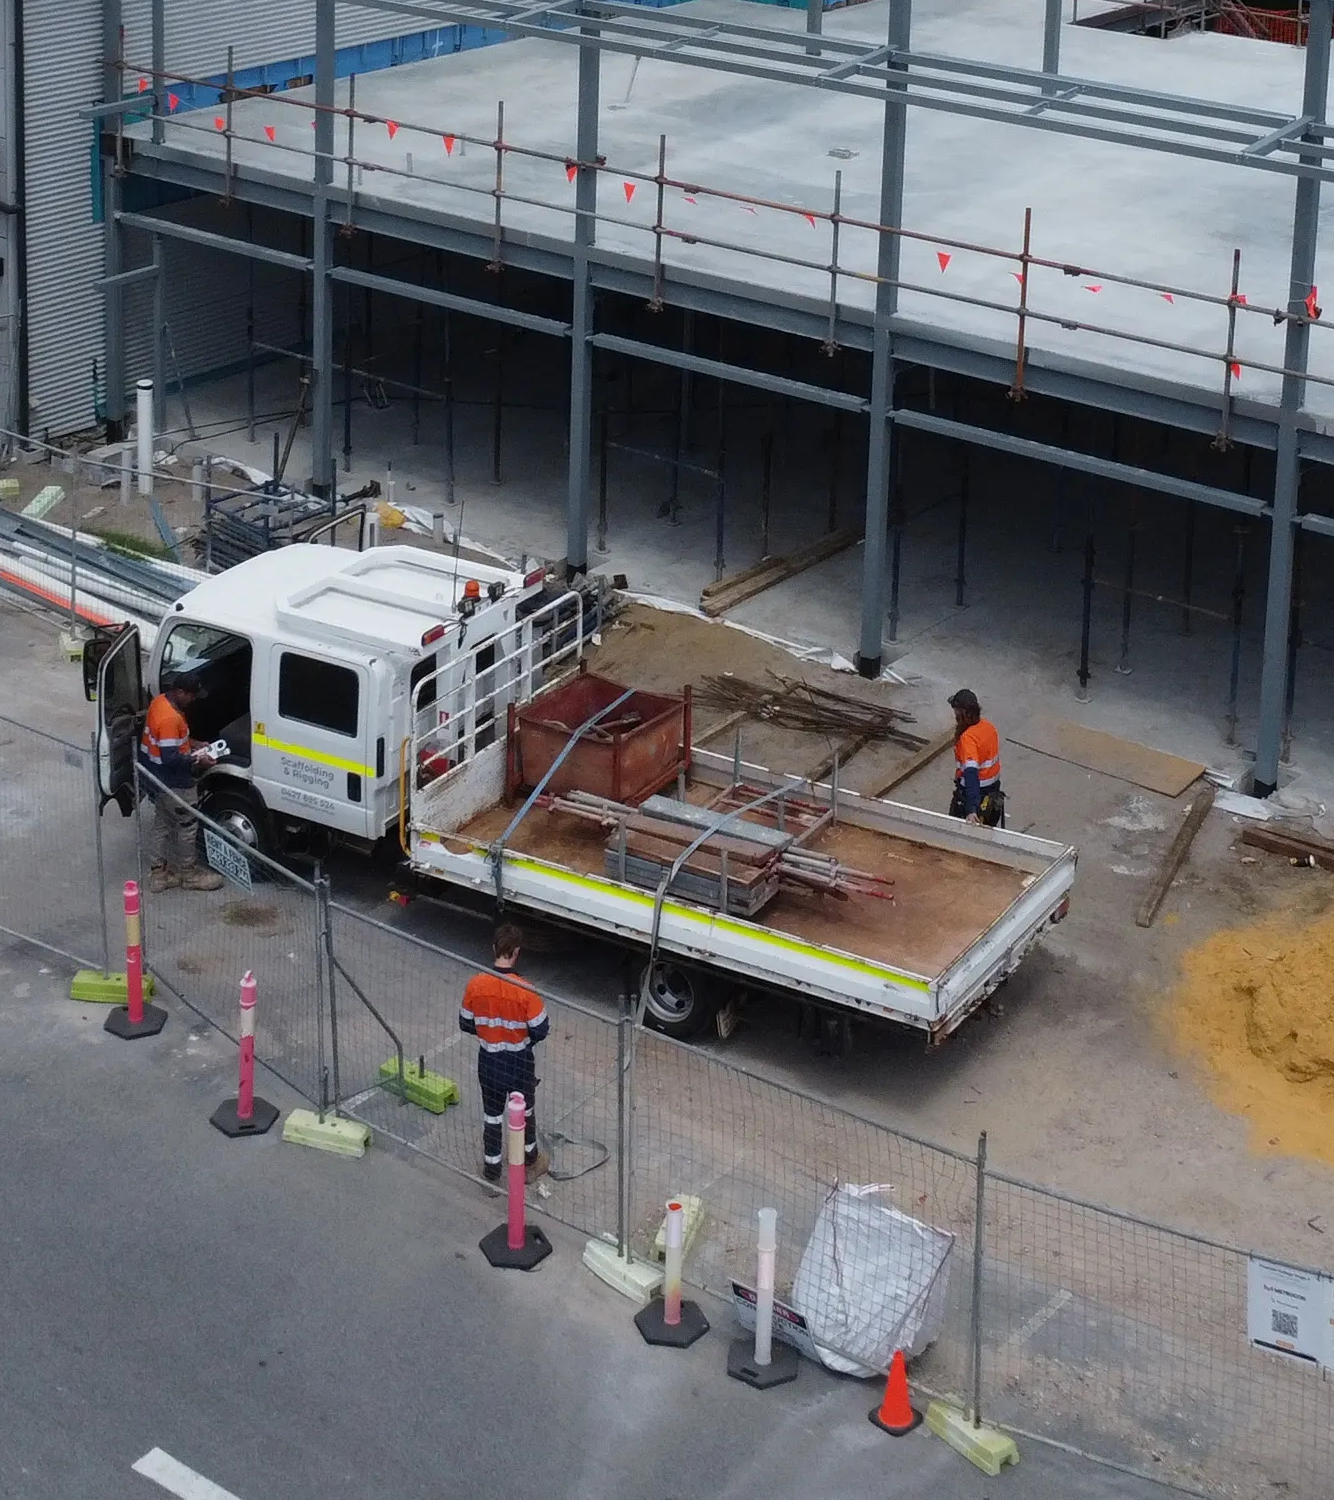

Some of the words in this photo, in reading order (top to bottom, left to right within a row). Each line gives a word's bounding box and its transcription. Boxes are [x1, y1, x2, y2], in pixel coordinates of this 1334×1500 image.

[280, 756, 335, 782] Scaffolding
[283, 766, 290, 776] &
[292, 769, 330, 790] Rigging
